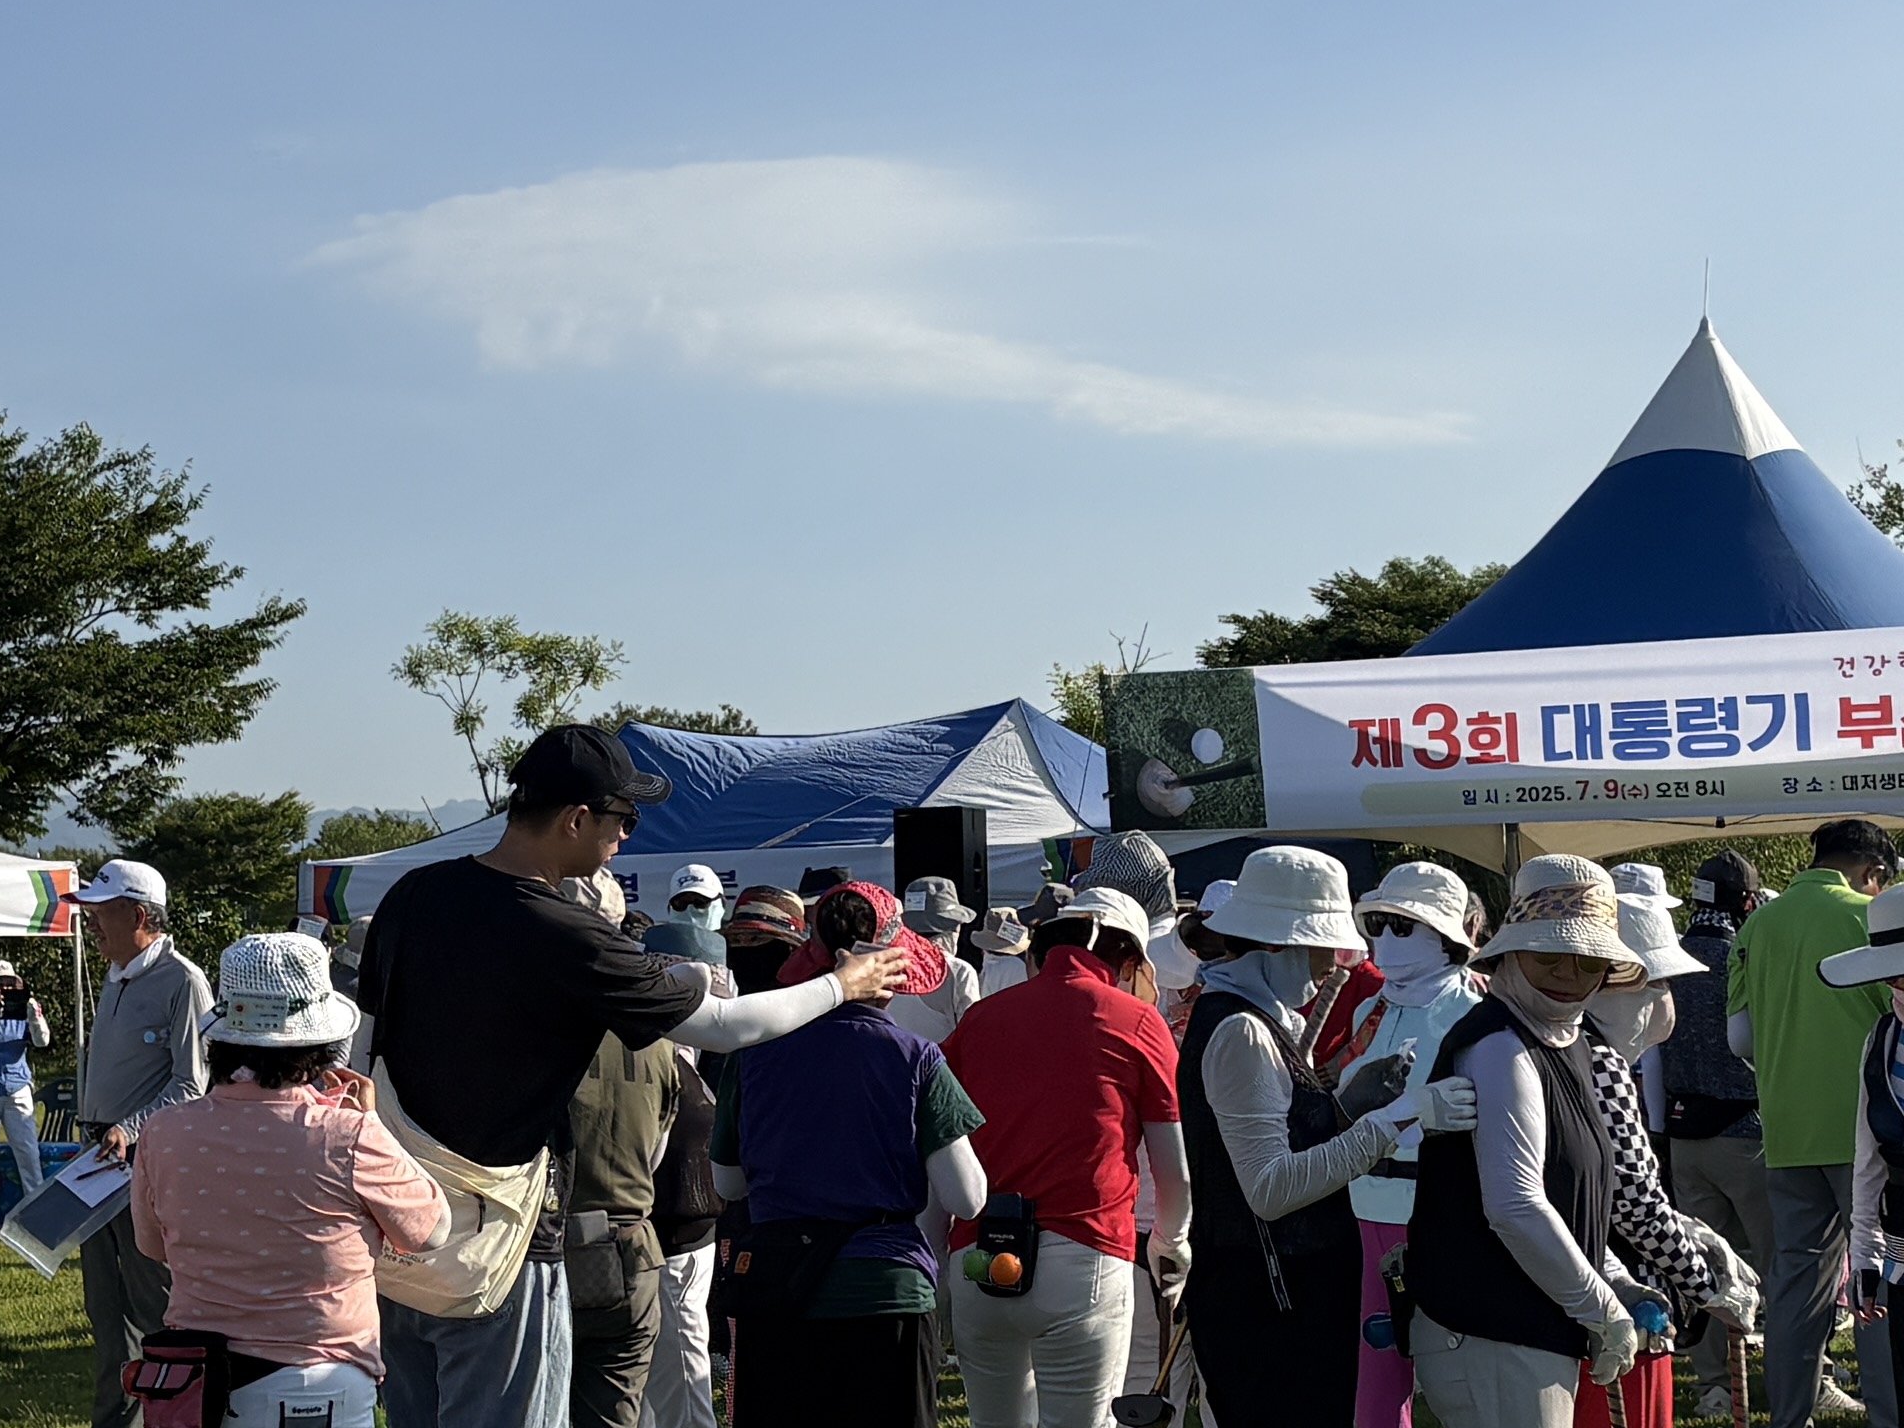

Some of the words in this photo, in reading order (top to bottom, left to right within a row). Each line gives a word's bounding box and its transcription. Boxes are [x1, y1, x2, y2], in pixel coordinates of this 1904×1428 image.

[1347, 702, 1521, 771] 제3회
[1540, 692, 1812, 763] 대통령기
[1655, 780, 1690, 799] 오전
[1695, 779, 1726, 797] 8시
